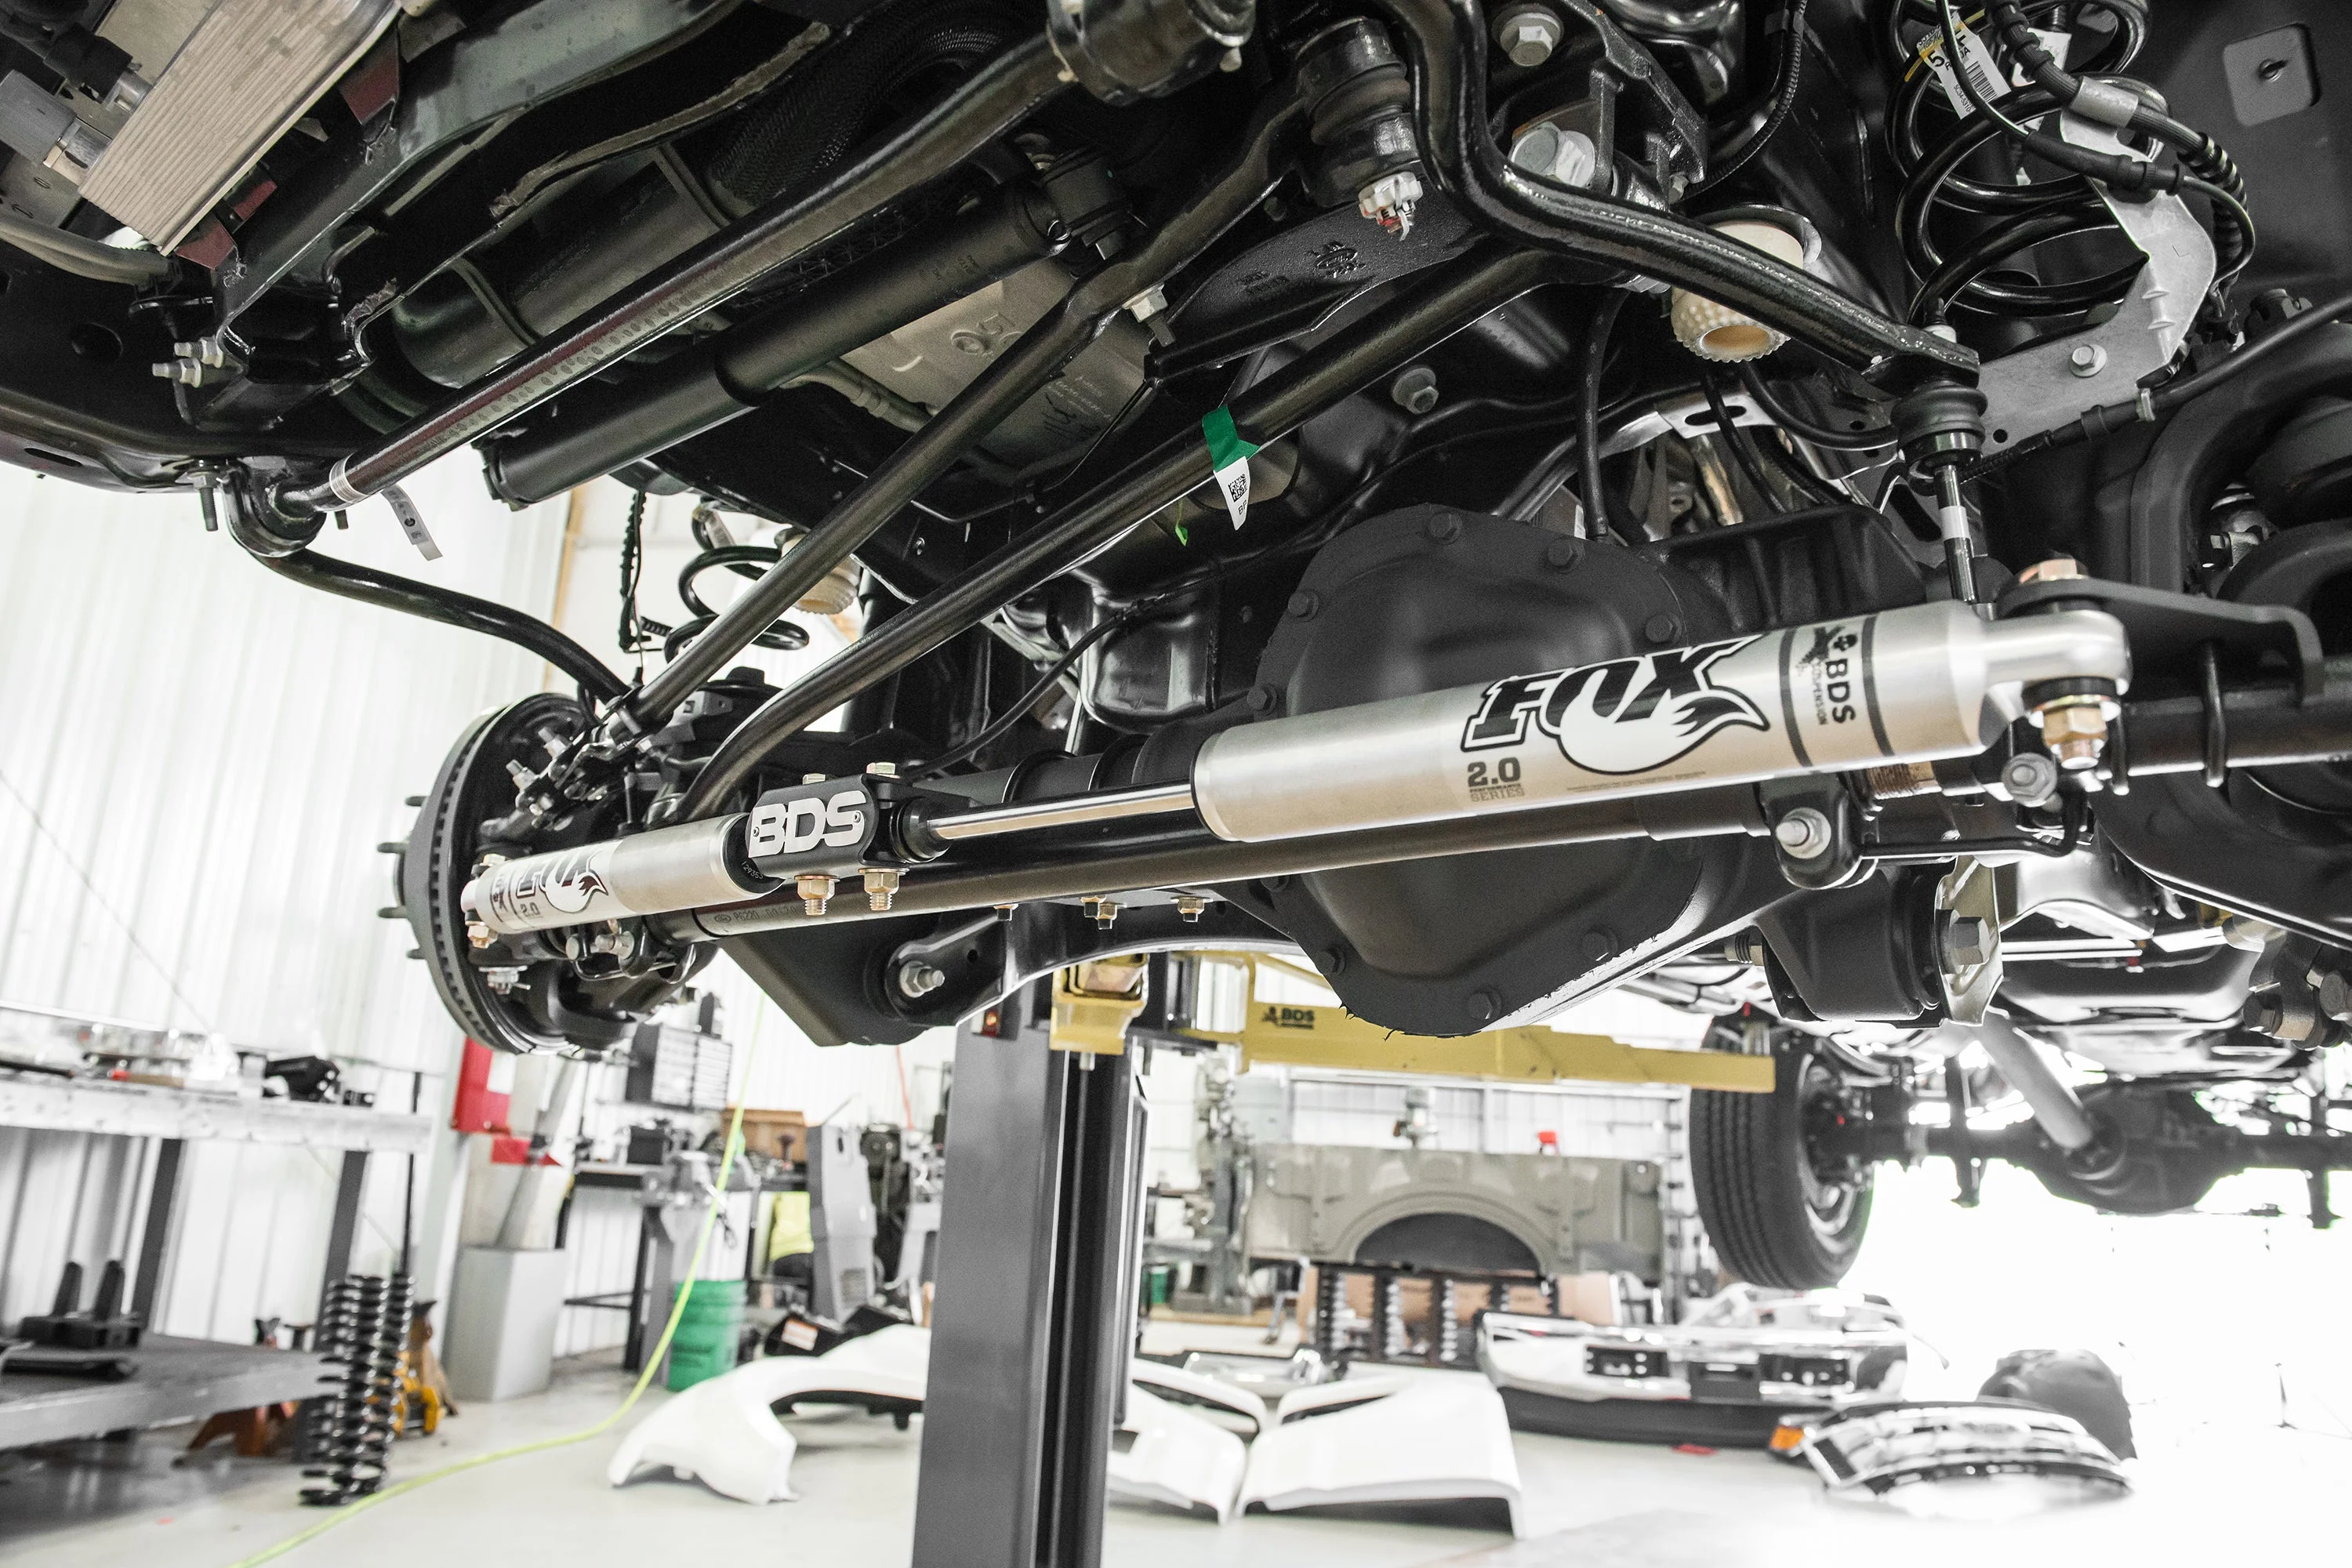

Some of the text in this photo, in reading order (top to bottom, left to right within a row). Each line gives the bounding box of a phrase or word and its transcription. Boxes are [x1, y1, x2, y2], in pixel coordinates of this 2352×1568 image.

[1461, 633, 1770, 775] FOX
[1825, 658, 1856, 724] BDS
[1467, 757, 1521, 787] 2.0
[1470, 786, 1525, 802] SERIES
[748, 789, 866, 858] BDS
[1281, 1007, 1315, 1022] BDS
